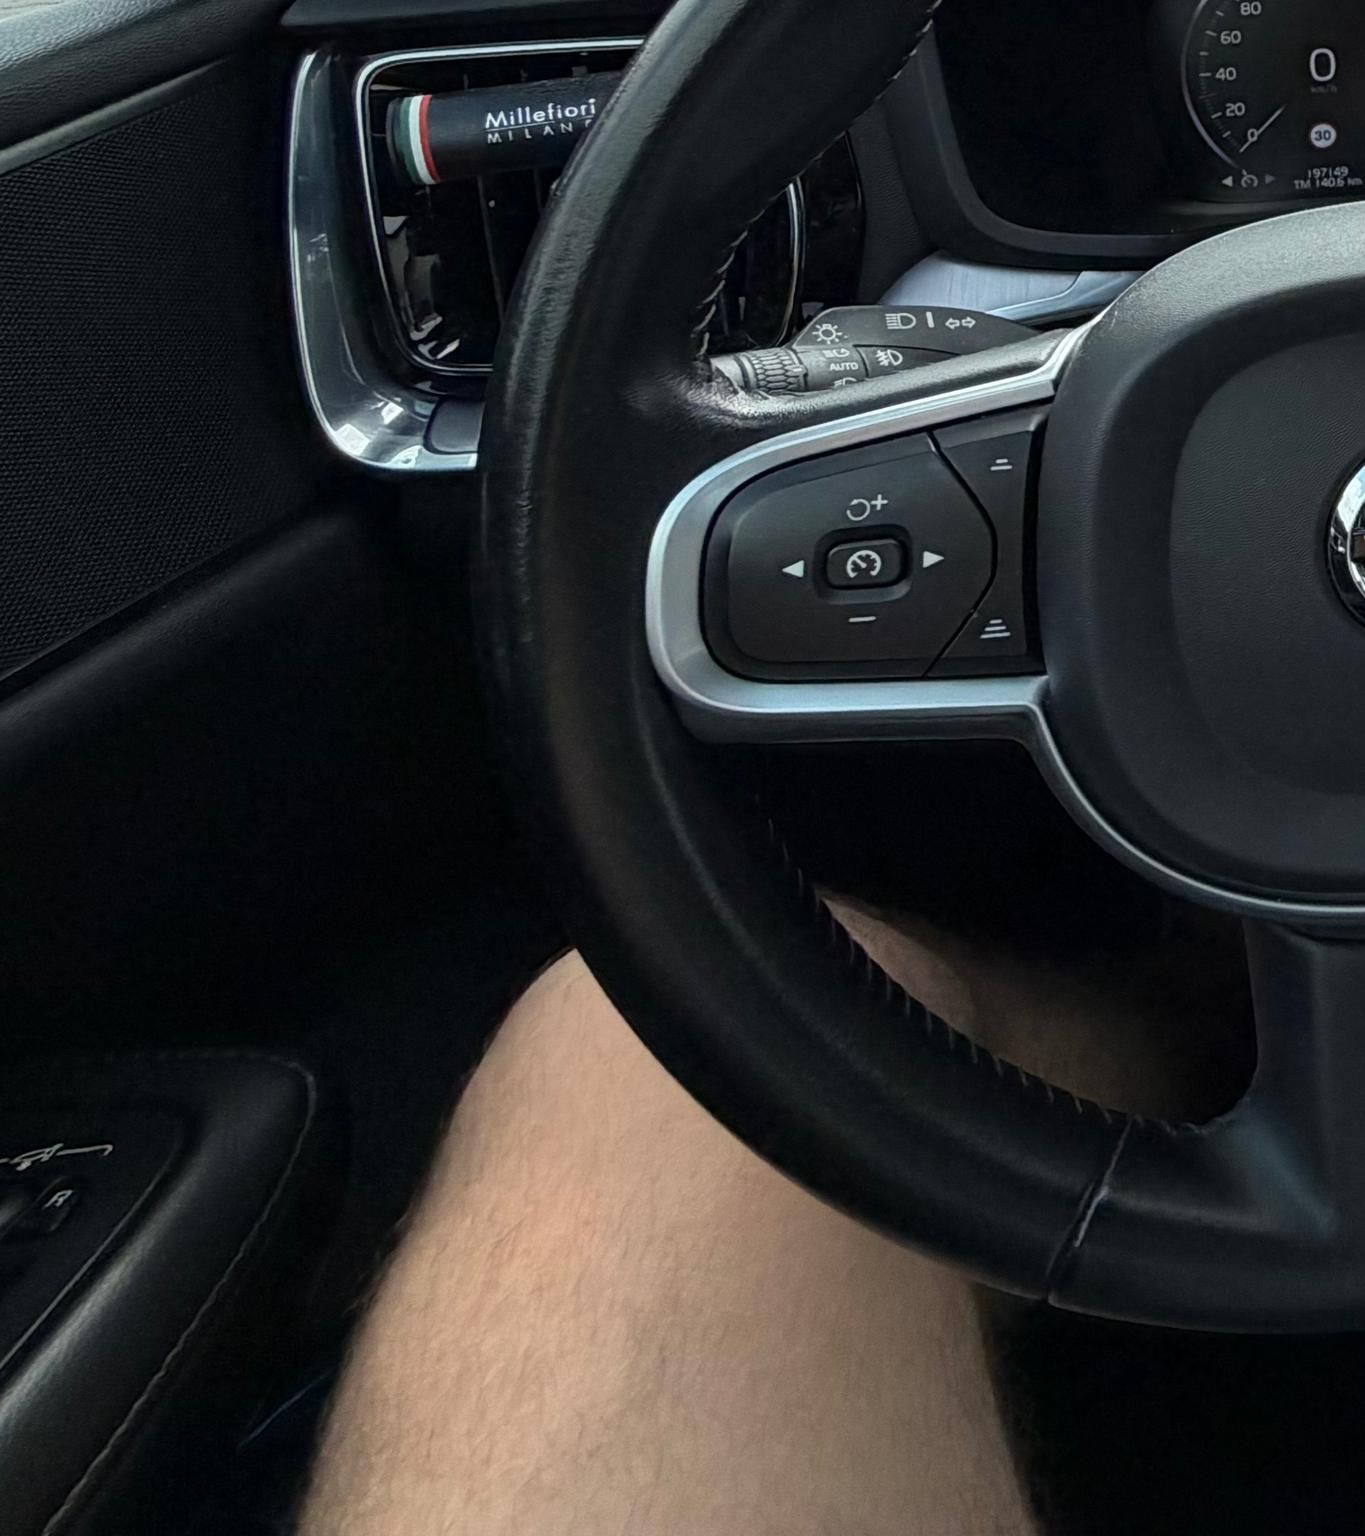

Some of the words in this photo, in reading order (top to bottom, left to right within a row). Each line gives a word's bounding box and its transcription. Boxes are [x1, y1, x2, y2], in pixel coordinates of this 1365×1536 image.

[1240, 1, 1262, 15] 80
[1220, 30, 1242, 44] 60
[1309, 48, 1337, 82] 0
[1215, 66, 1237, 81] 40
[485, 98, 597, 129] Millefiori
[1225, 102, 1246, 117] 20
[1247, 128, 1259, 143] 0
[1314, 129, 1332, 141] 30
[1307, 166, 1350, 180] 197149
[1294, 178, 1311, 189] TM
[829, 360, 859, 372] AUTO
